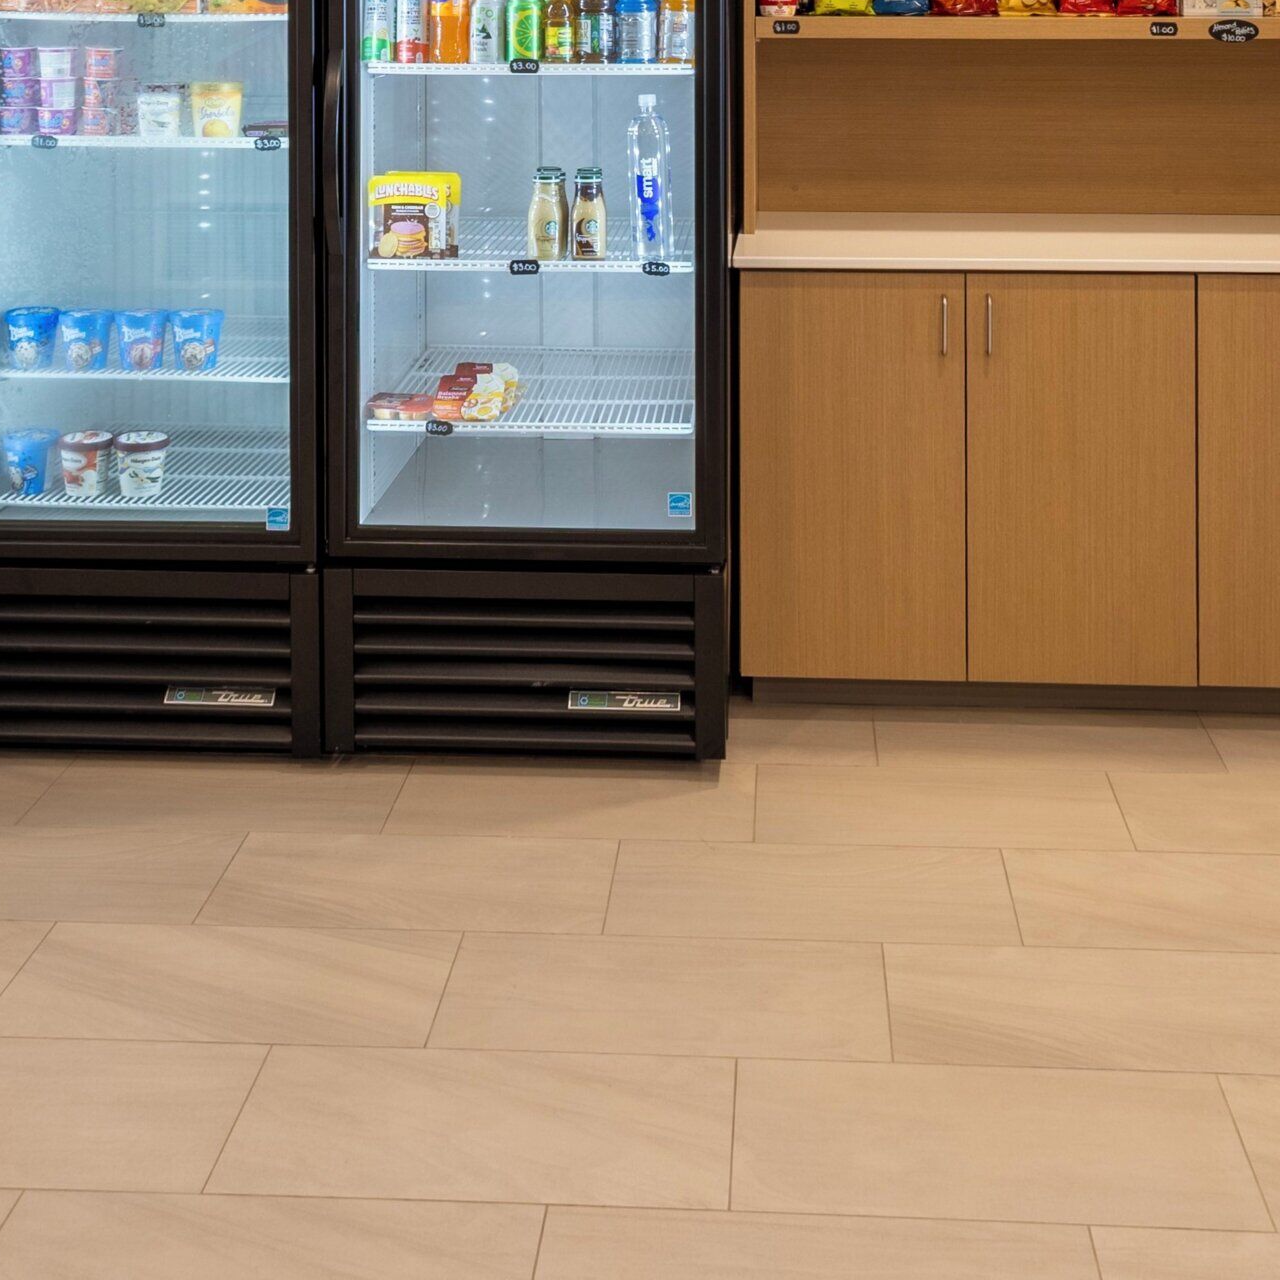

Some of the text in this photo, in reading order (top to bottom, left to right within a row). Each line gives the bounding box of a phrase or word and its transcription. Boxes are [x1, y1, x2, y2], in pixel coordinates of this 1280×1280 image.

[1212, 21, 1237, 32] Almond
[1222, 33, 1246, 42] $10.00
[511, 62, 537, 71] $3.00
[640, 157, 654, 199] smart
[375, 182, 439, 201] LUNCHABLES
[512, 263, 537, 272] $3.00
[645, 263, 669, 273] $5.00
